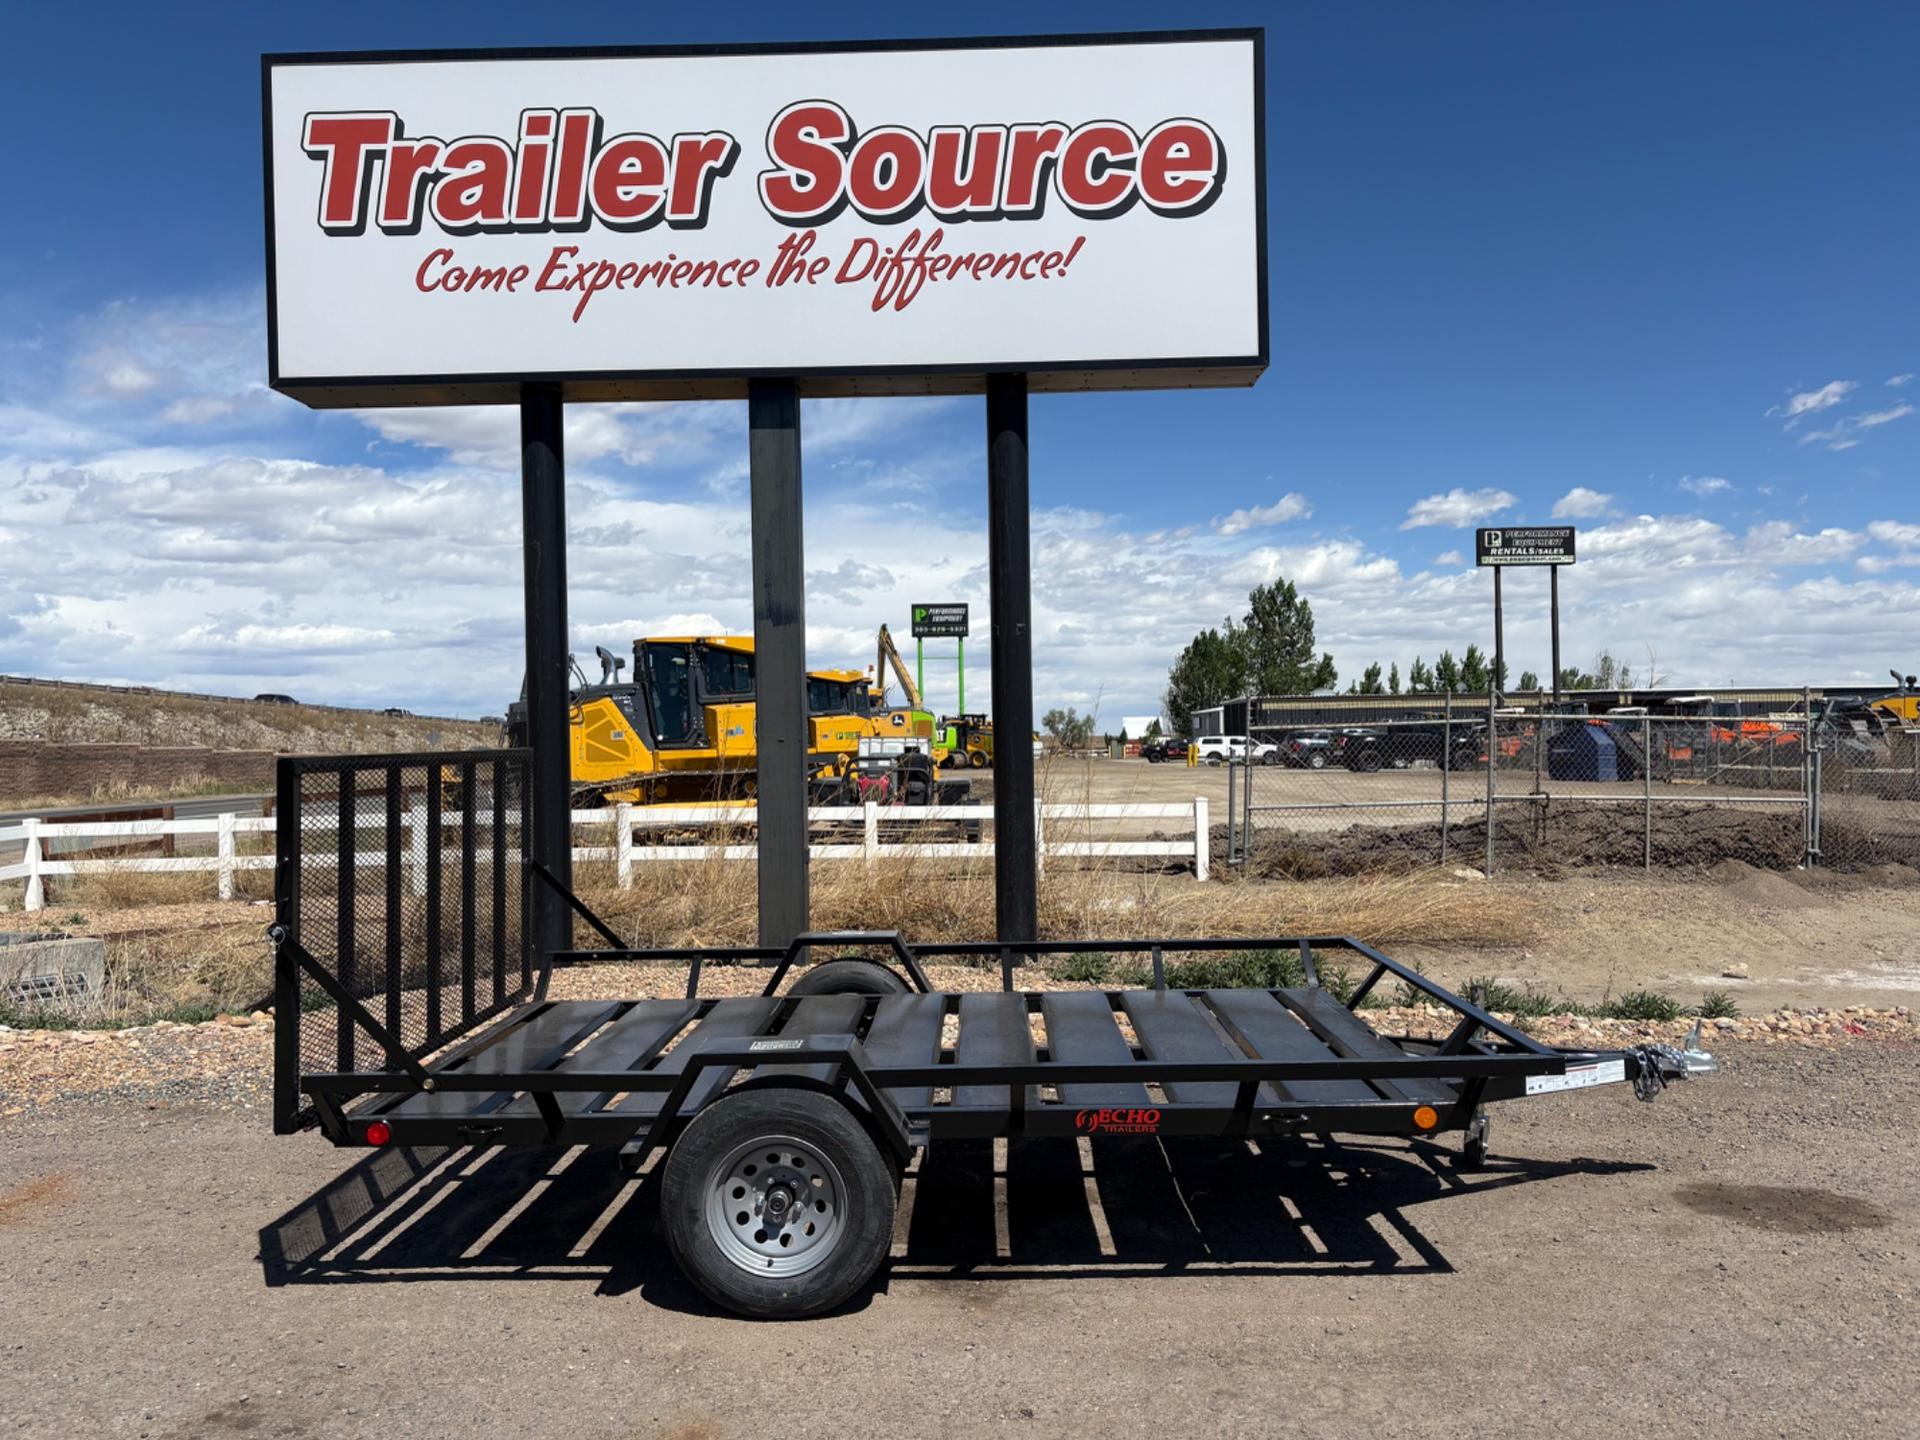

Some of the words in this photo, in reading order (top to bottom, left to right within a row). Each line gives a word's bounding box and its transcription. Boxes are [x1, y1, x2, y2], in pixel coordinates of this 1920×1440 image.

[302, 108, 740, 236] Trailer
[759, 100, 1226, 227] Source
[416, 248, 529, 292] Come
[535, 246, 759, 322] Experience
[767, 230, 831, 288] the
[836, 229, 1086, 312] Difference!
[1099, 1109, 1161, 1124] ECHO
